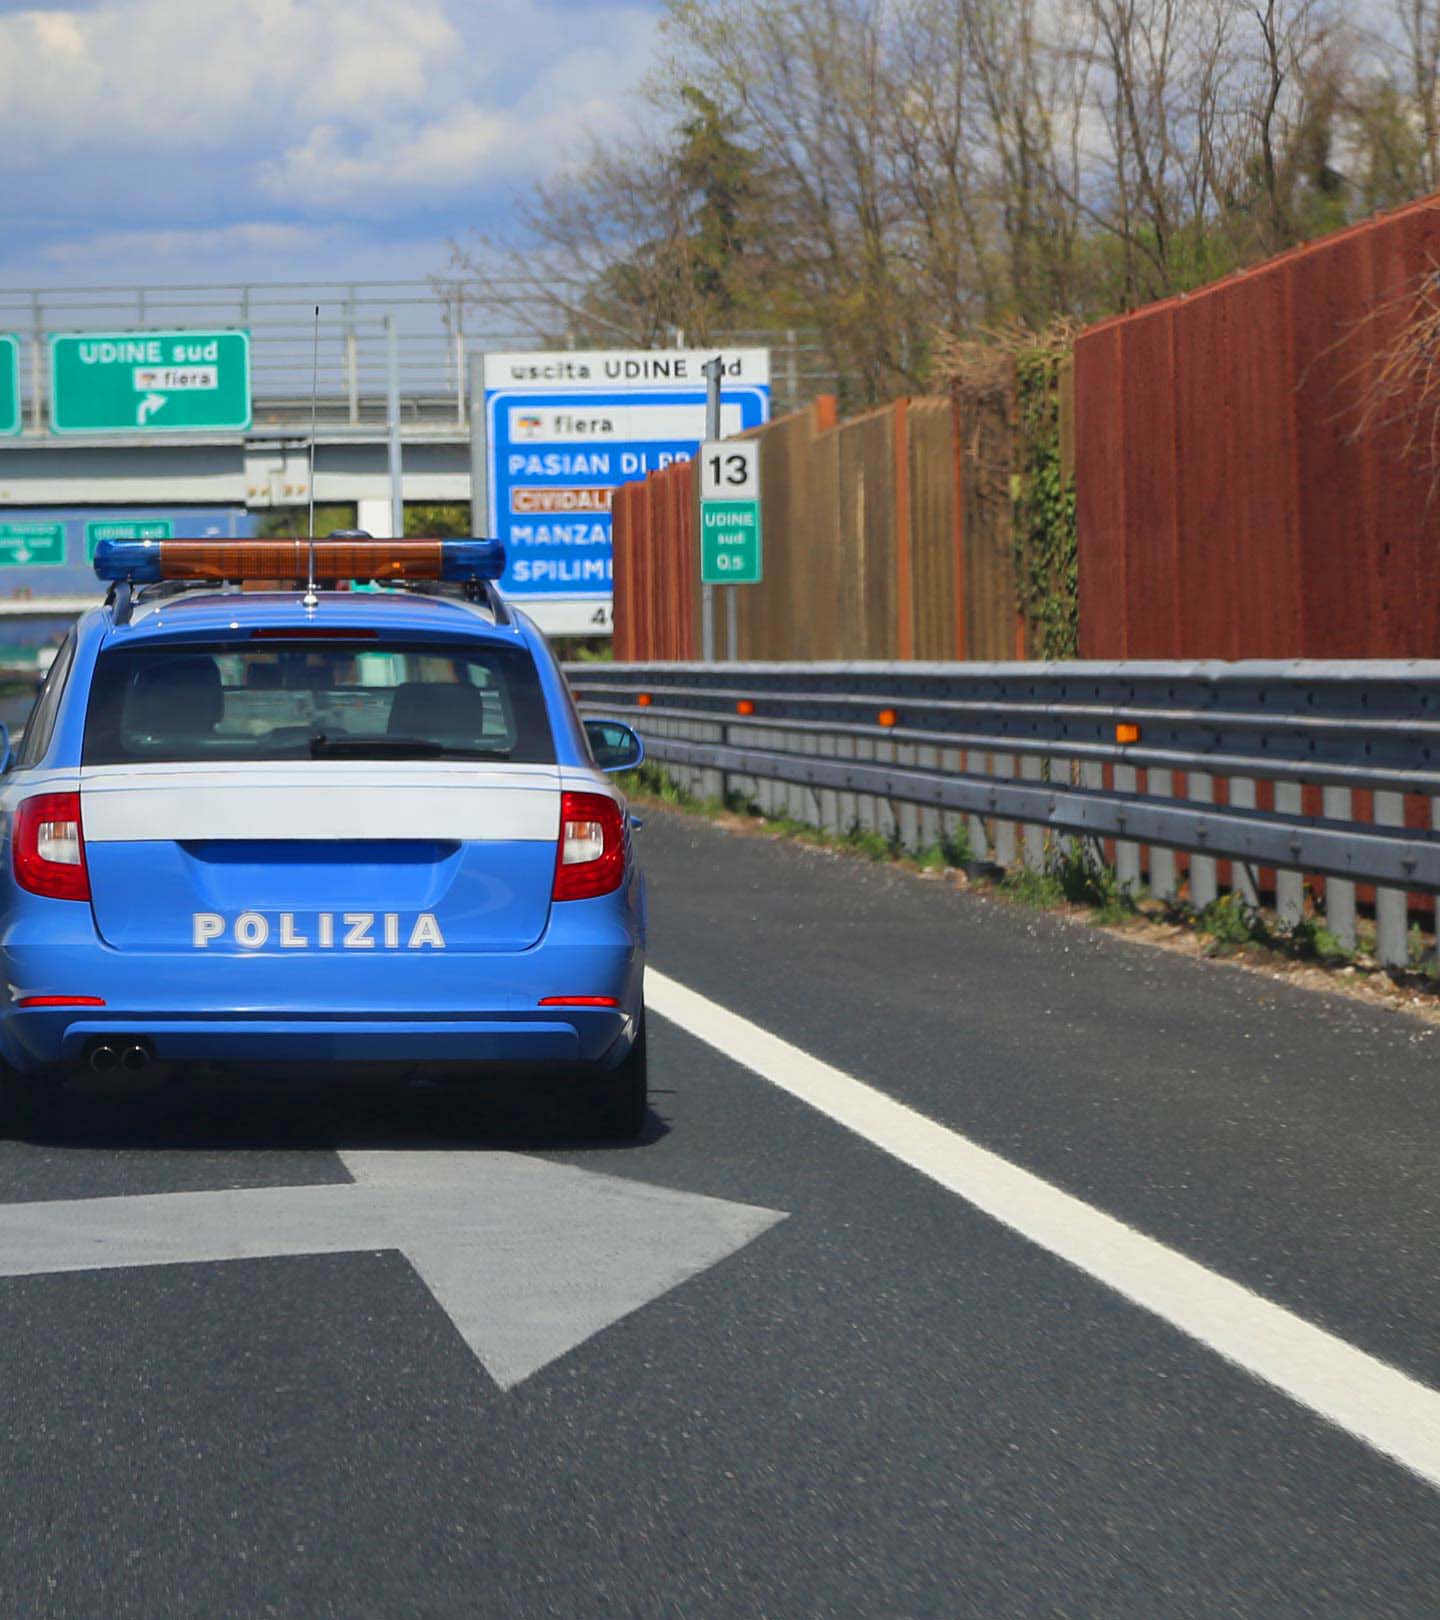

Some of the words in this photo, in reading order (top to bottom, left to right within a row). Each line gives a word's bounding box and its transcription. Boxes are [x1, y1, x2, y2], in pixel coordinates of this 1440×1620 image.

[79, 341, 162, 364] UDINE
[173, 339, 218, 361] sud
[164, 370, 211, 387] fiera
[511, 361, 590, 380] uscita
[605, 359, 688, 378] UDINE
[554, 415, 613, 434] fiera
[508, 453, 610, 475] PASIAN
[621, 453, 646, 473] DI
[709, 455, 748, 486] 13
[705, 511, 754, 527] UDINE
[591, 605, 614, 625] 4
[192, 912, 447, 949] POLIZIA
